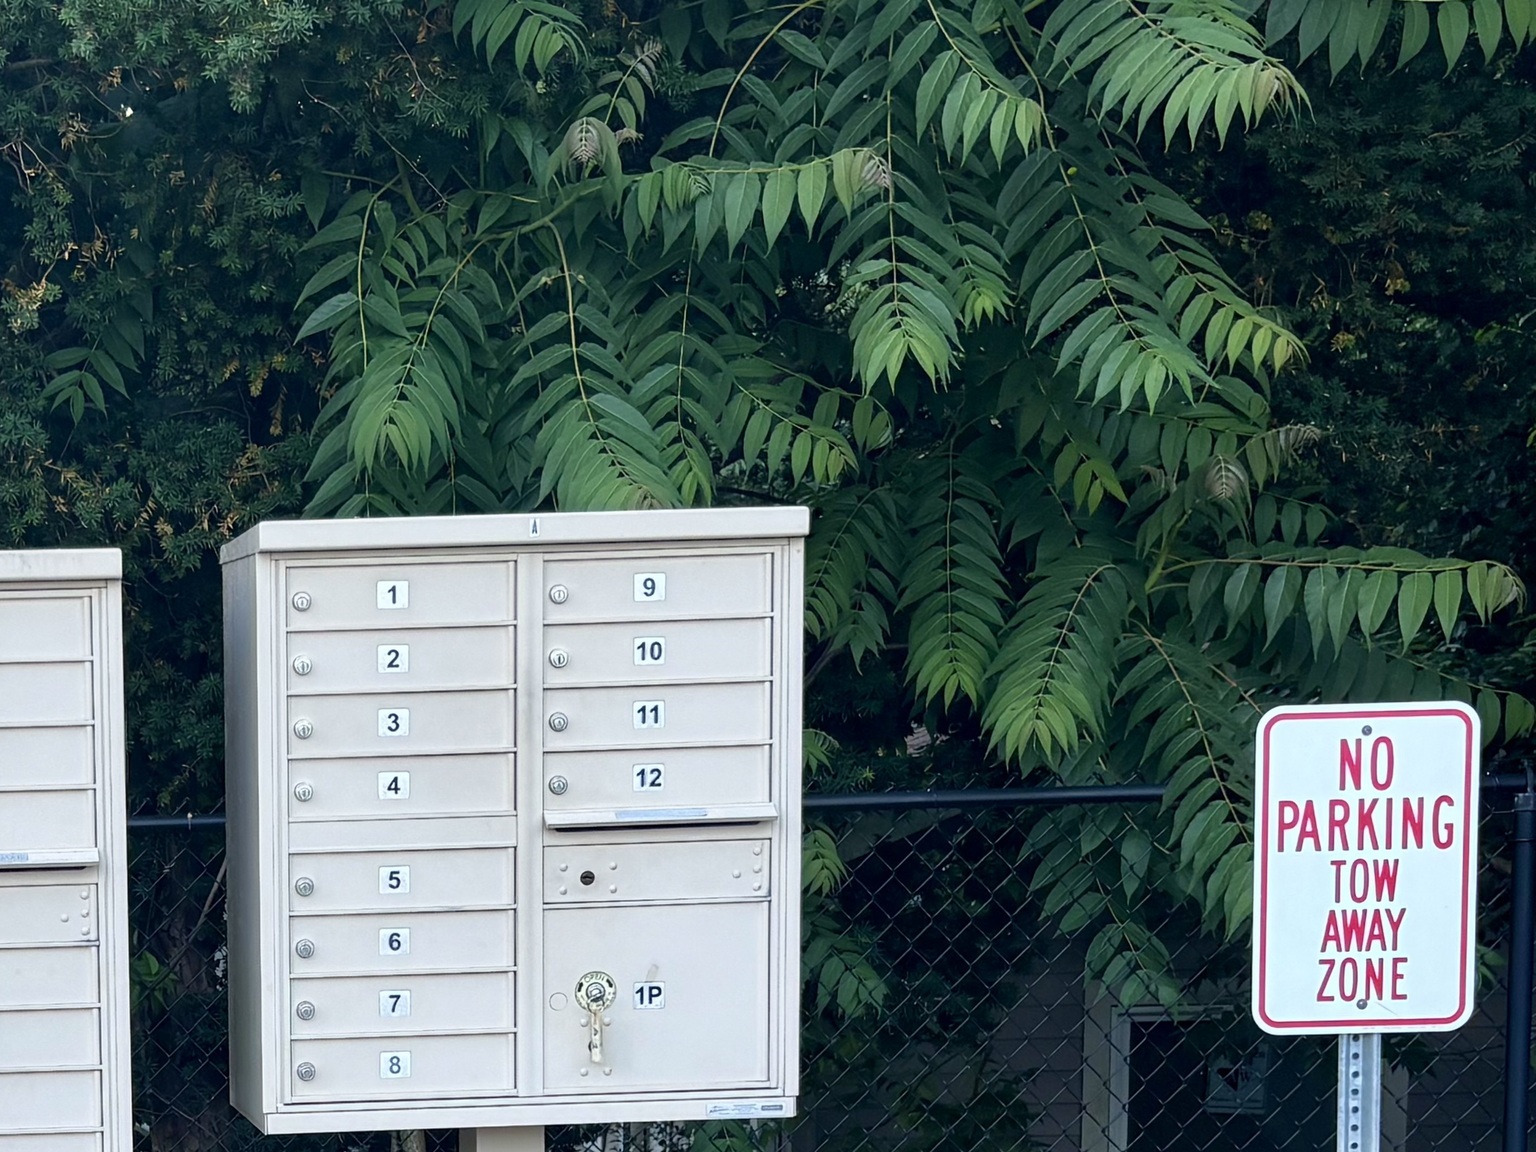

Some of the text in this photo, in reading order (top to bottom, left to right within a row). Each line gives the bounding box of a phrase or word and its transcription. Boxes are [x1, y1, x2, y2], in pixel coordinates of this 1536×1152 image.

[387, 585, 397, 604] 1
[643, 577, 656, 597] 9
[387, 649, 400, 668] 2
[636, 641, 663, 661] 10
[387, 713, 400, 732] 3
[637, 704, 659, 725] 11
[1338, 736, 1395, 791] NO
[387, 776, 401, 795] 4
[636, 768, 662, 788] 12
[1277, 795, 1455, 853] PARKING
[388, 870, 401, 890] 5
[1330, 858, 1399, 904] TOW
[1320, 907, 1407, 953] AWAY
[388, 932, 402, 951] 6
[1316, 956, 1409, 1002] ZONE
[388, 994, 401, 1013] 7
[635, 985, 662, 1005] 1P
[389, 1055, 401, 1074] 8
